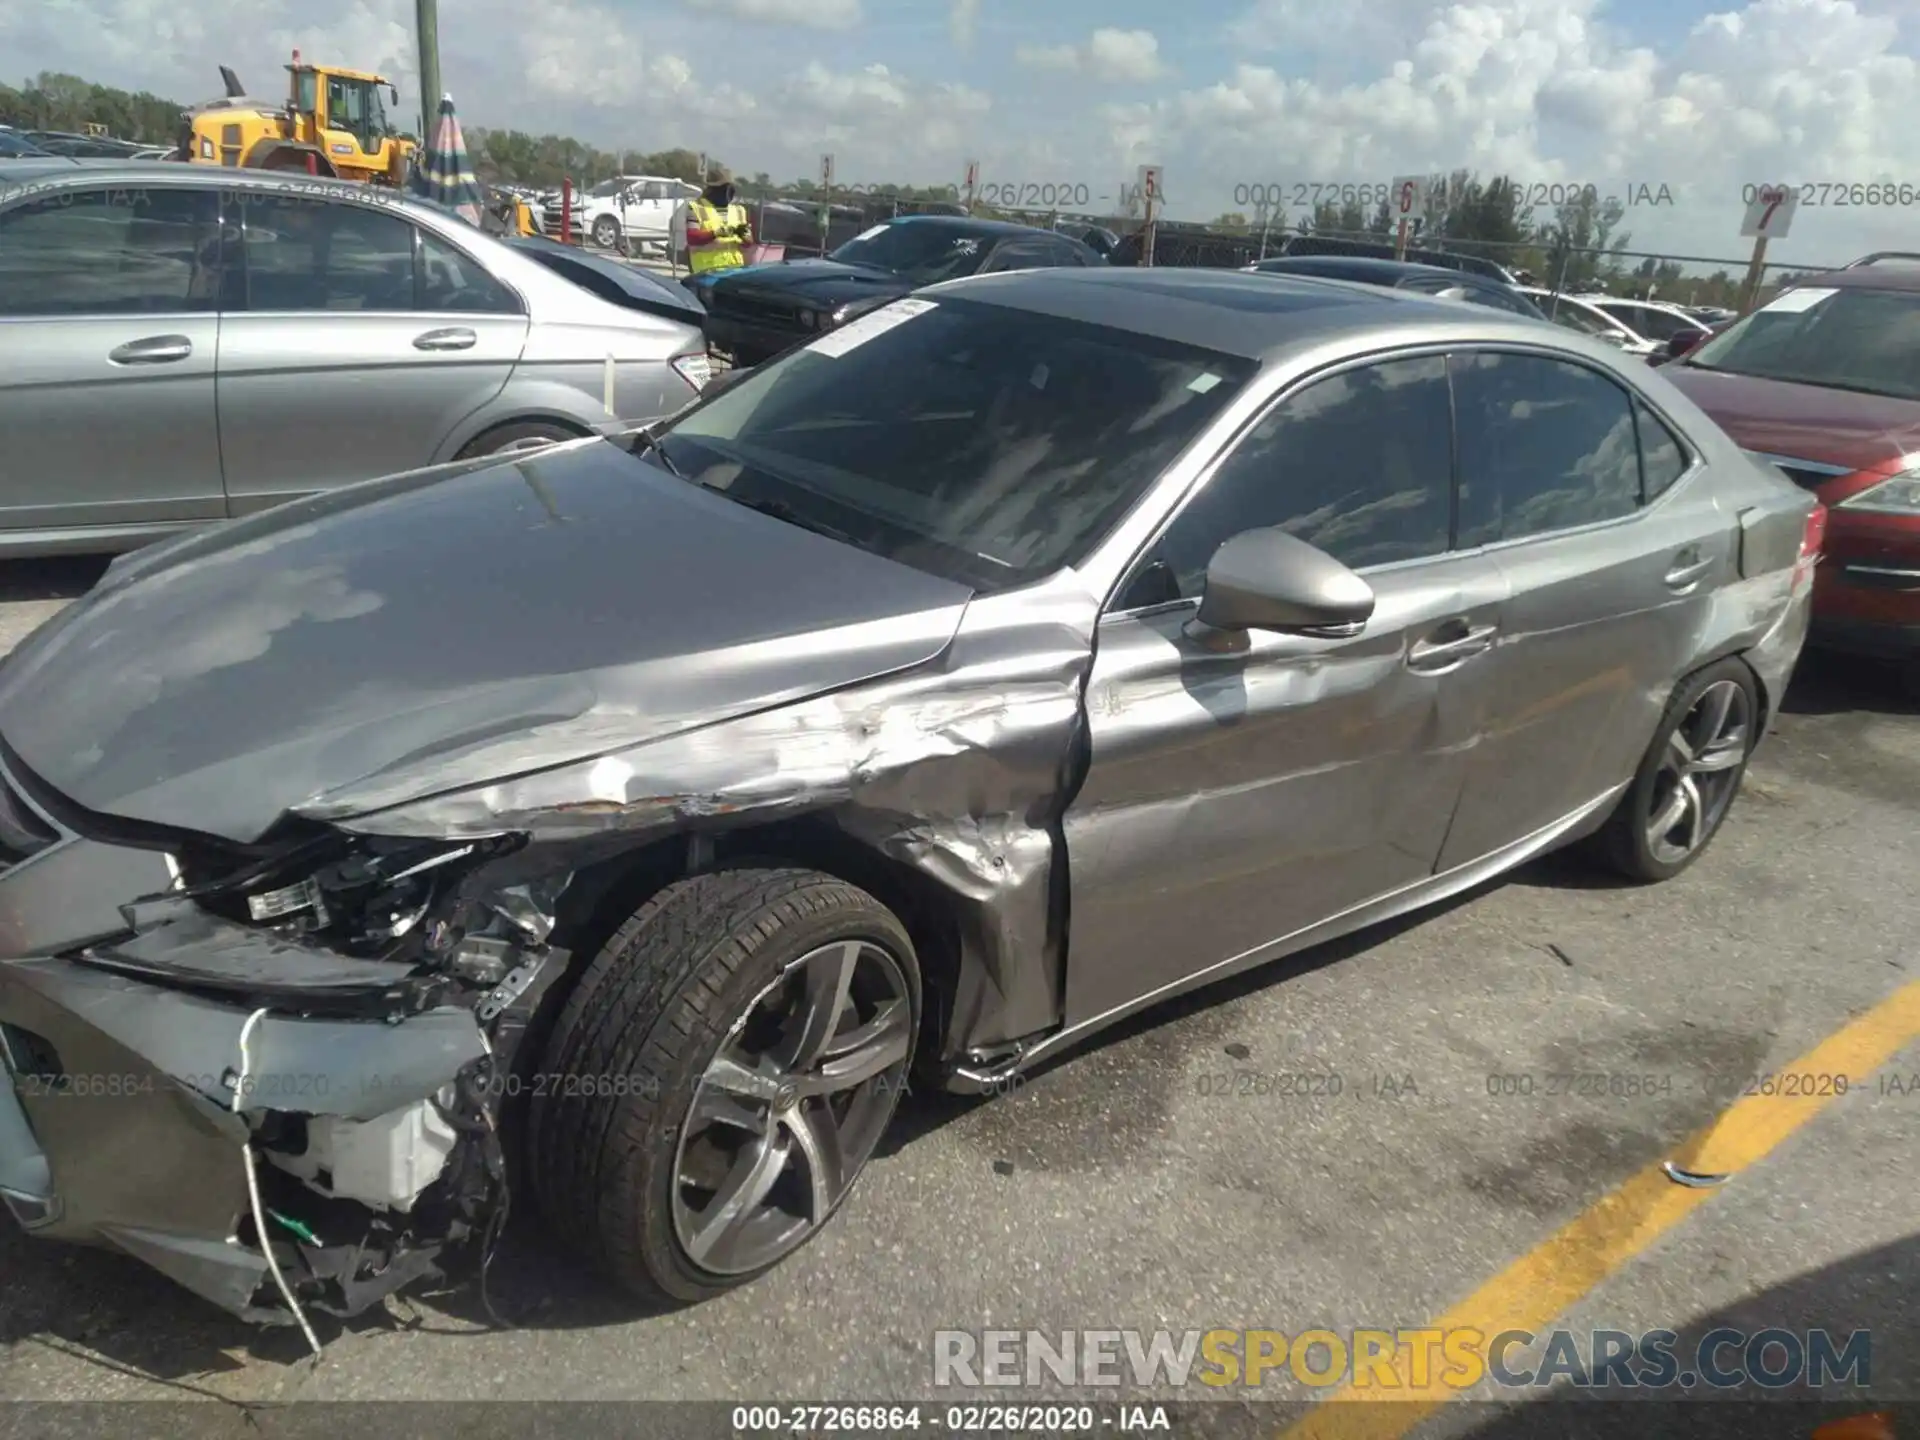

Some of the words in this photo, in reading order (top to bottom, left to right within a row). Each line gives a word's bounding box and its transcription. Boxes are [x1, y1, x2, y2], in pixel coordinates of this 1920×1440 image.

[1145, 170, 1155, 197] 5
[1400, 181, 1413, 213] 6
[1757, 191, 1783, 230] 7
